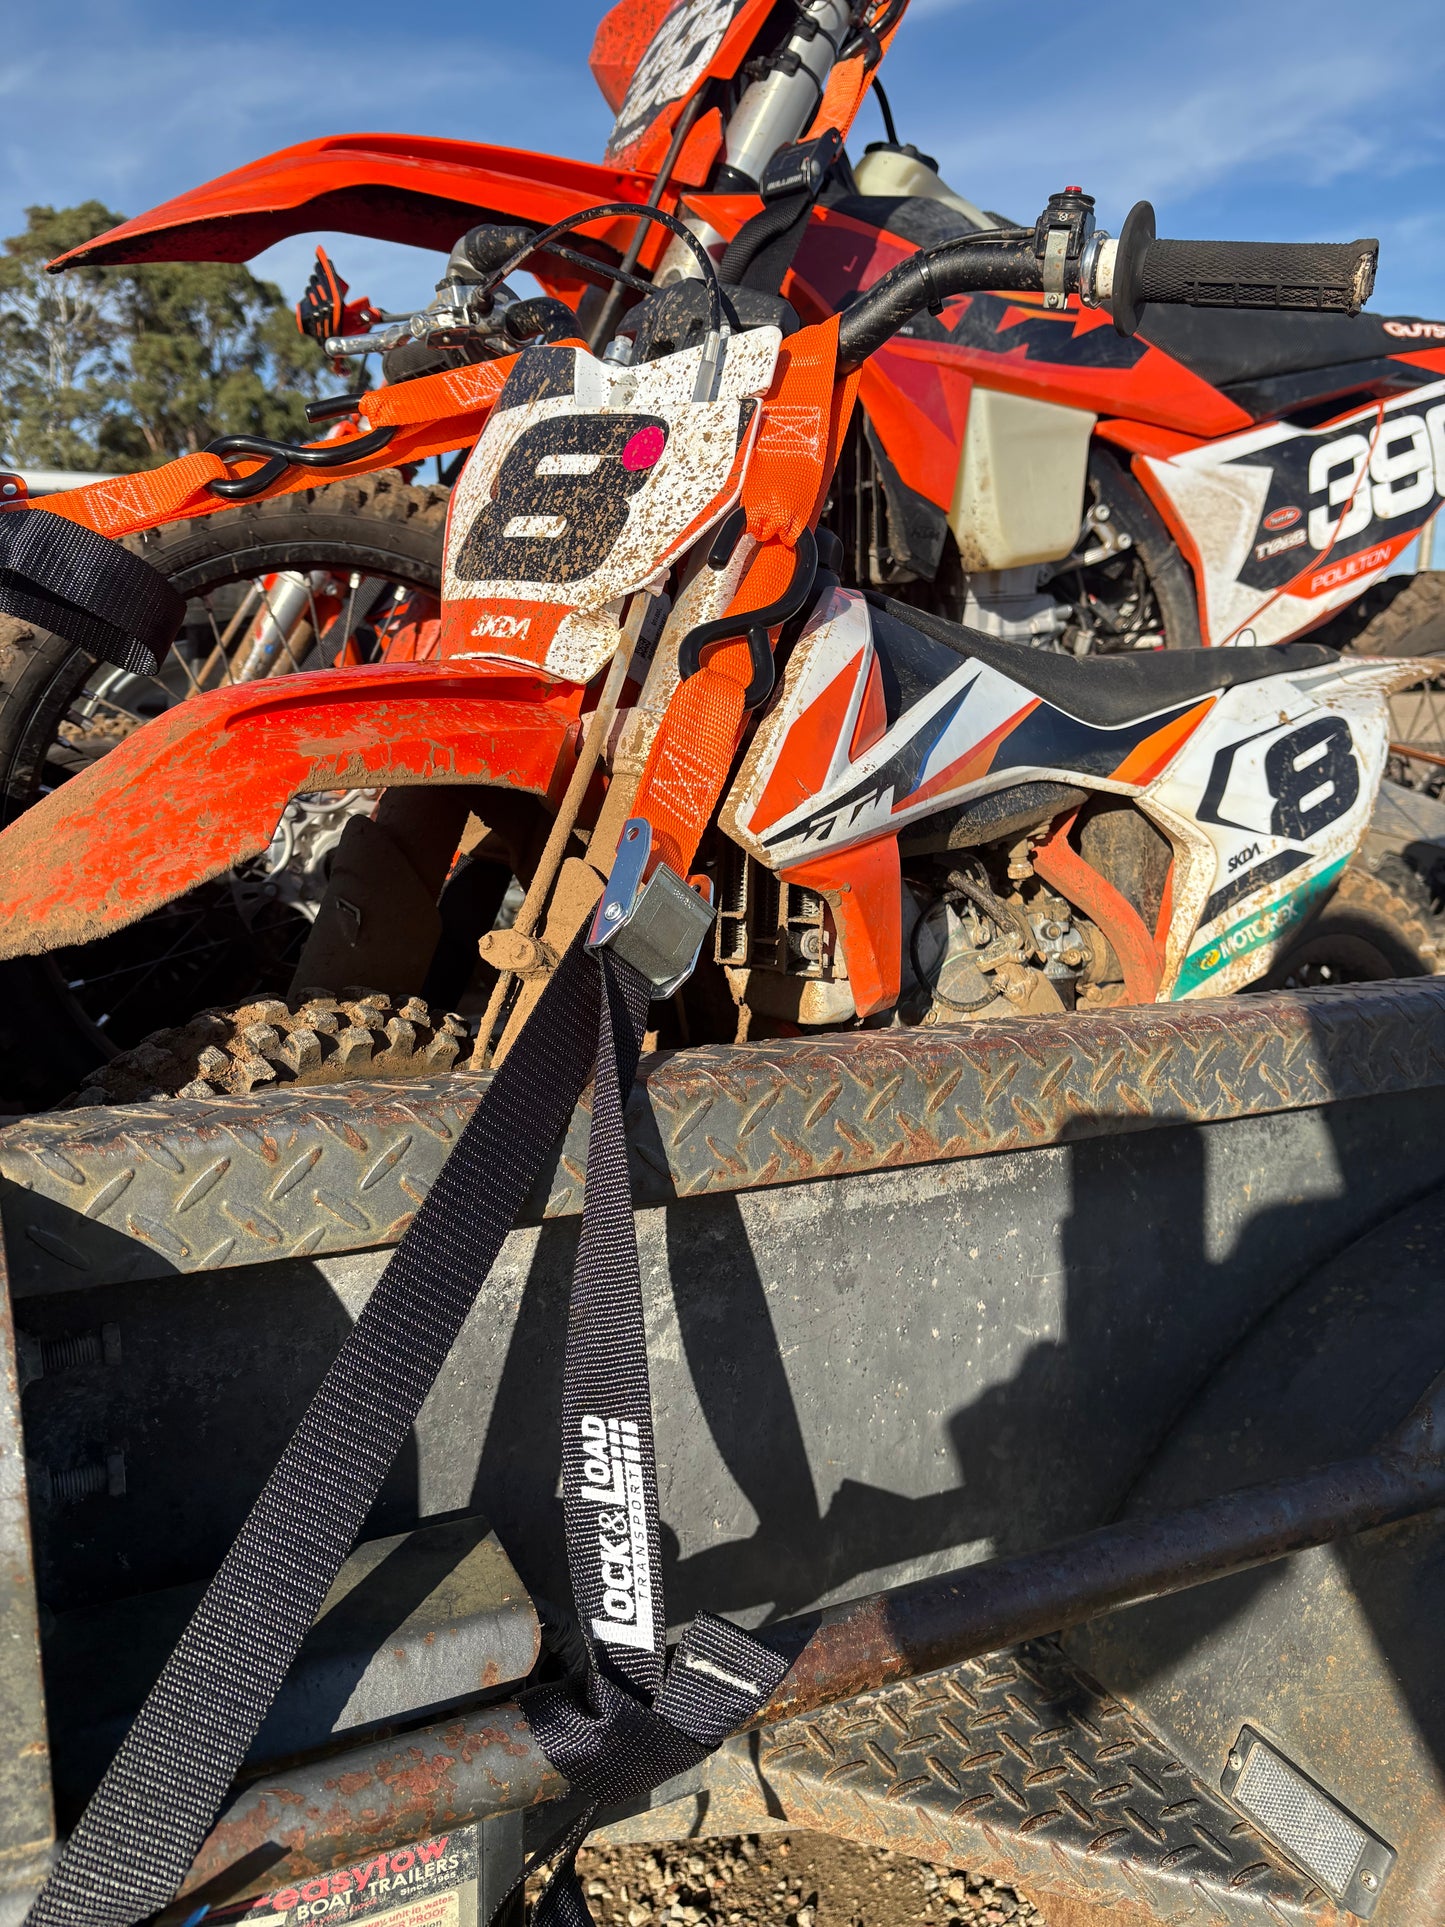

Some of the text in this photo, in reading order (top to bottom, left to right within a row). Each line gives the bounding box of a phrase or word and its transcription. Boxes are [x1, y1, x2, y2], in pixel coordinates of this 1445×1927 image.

[455, 414, 670, 583] 8
[1311, 545, 1392, 593] POULTON
[1264, 716, 1360, 841] 8
[1220, 899, 1298, 959] MOTOREX
[629, 1470, 649, 1600] TRANSPORT
[272, 1837, 449, 1911] easytow
[297, 1854, 459, 1920] BOAT TRAILERS
[400, 1871, 457, 1896] Since 1965
[389, 1909, 409, 1923] unit
[411, 1905, 422, 1915] in
